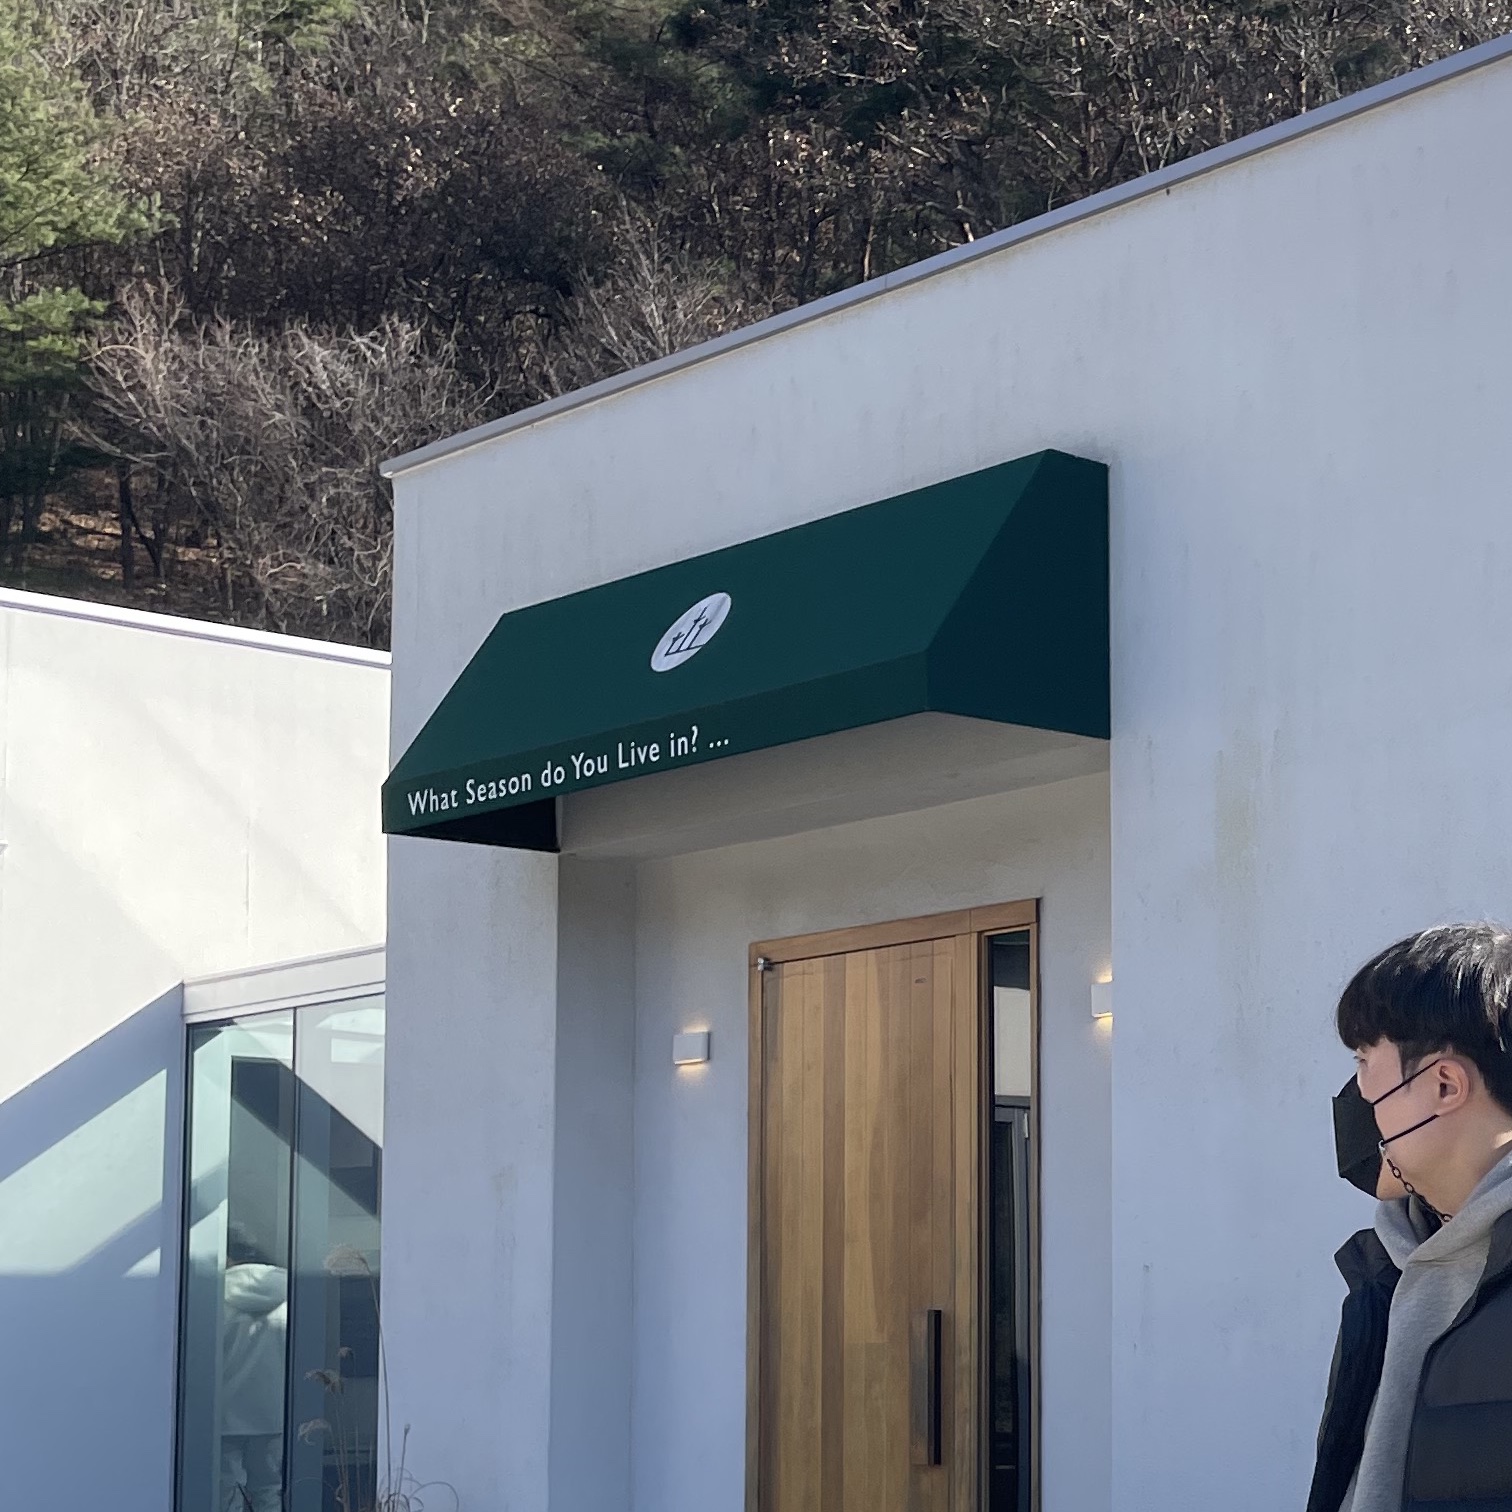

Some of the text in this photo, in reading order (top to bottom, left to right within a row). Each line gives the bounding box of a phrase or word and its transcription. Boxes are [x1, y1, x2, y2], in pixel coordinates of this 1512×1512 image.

[407, 787, 459, 816] What
[465, 773, 532, 805] Season
[540, 760, 565, 787] do
[570, 752, 608, 780] You
[618, 741, 660, 769] Live
[669, 725, 698, 758] in?
